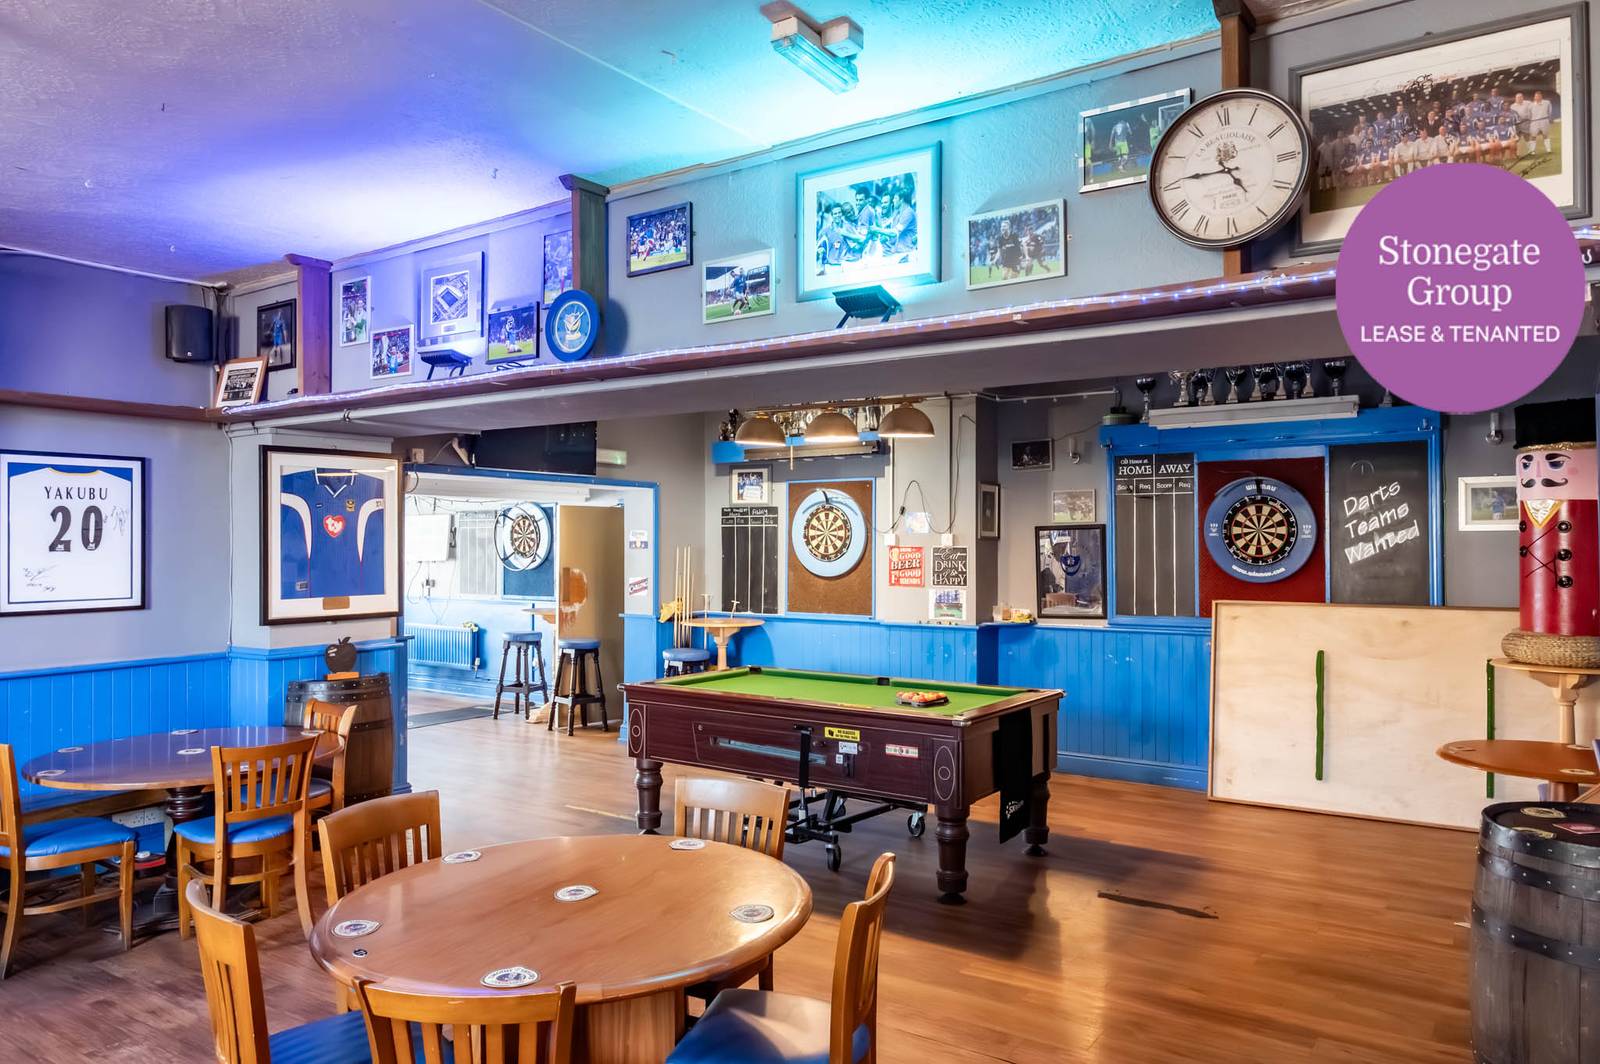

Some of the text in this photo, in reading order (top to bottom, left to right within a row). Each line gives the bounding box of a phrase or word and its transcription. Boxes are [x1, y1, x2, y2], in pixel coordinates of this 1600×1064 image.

[1119, 465, 1152, 475] HOME
[1159, 464, 1191, 474] AWAY
[44, 486, 108, 501] YAKUBU
[1343, 481, 1400, 517] Darts
[1344, 502, 1409, 538] Teams
[48, 505, 103, 552] 20
[1344, 519, 1420, 564] Wanted
[891, 559, 921, 570] BEER
[934, 560, 967, 572] DRINK
[934, 573, 967, 585] HAPPY
